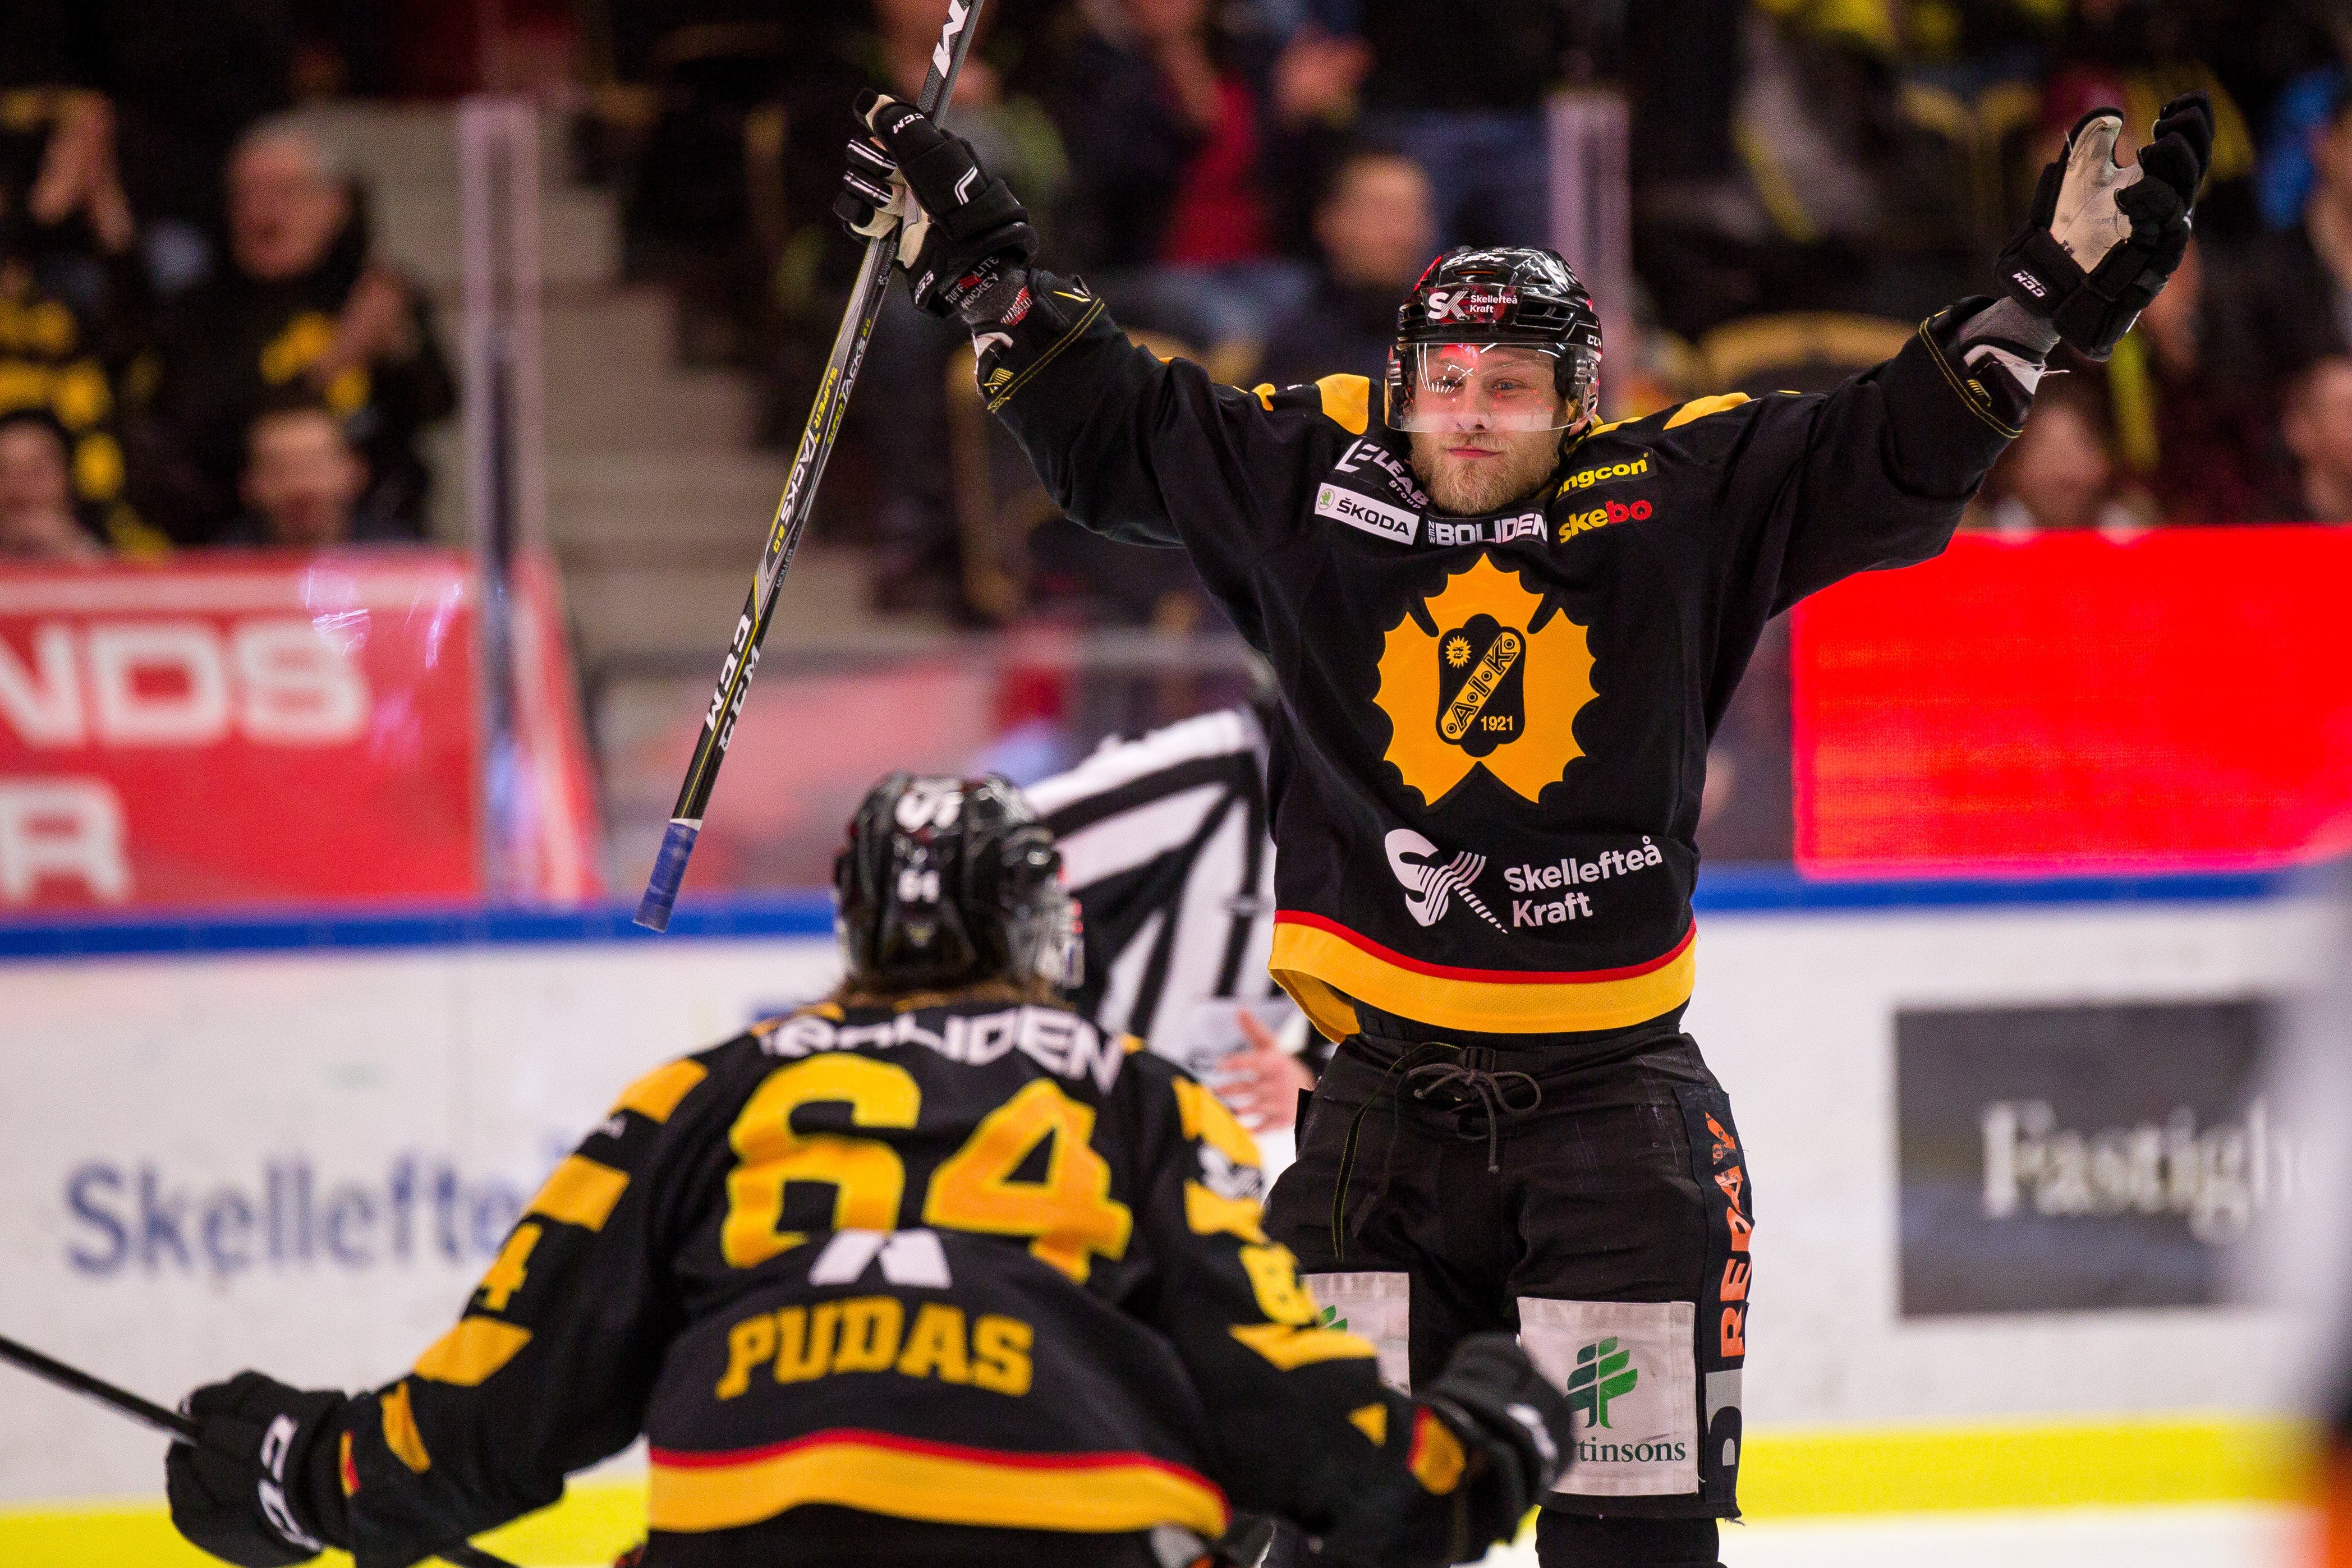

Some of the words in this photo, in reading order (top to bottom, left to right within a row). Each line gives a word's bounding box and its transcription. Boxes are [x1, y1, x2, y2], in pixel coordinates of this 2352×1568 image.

[1469, 294, 1518, 305] Skellefteå
[2012, 272, 2045, 297] CCM
[1469, 304, 1494, 314] Kraft
[1388, 479, 1421, 509] group
[1336, 496, 1410, 536] ŠKODA
[1436, 513, 1547, 546] BOLIDEN
[1559, 499, 1653, 544] skebo
[705, 614, 752, 732] CCM
[718, 644, 760, 752] CCM
[1481, 715, 1514, 732] 1921
[1504, 835, 1663, 893] Skellefteå
[1513, 892, 1594, 928] Kraft
[721, 1052, 1132, 1285] 64
[65, 1143, 530, 1278] Skellefte
[715, 1296, 1035, 1401] PUDAS
[1572, 1436, 1687, 1463] tinsons
